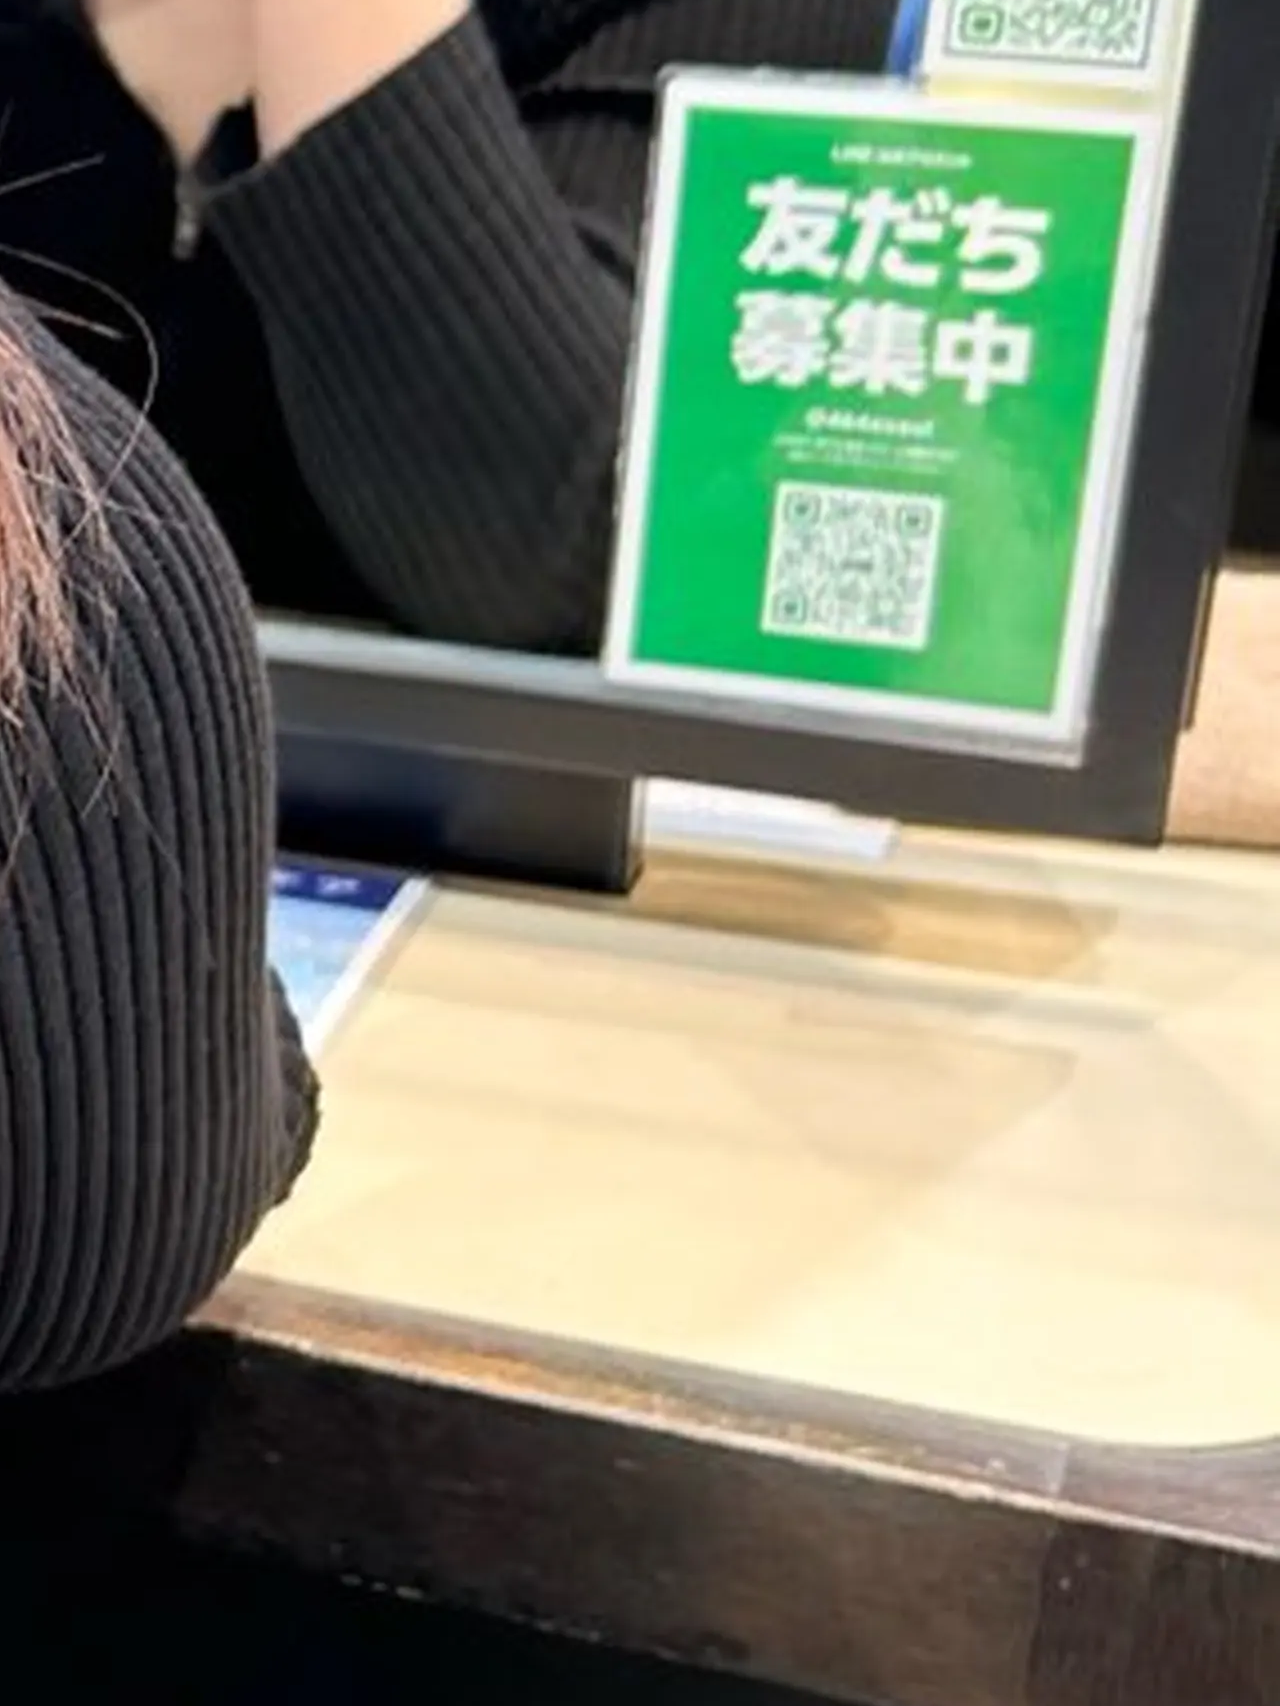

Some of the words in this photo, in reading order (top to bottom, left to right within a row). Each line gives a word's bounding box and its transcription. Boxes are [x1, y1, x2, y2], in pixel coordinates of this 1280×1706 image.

[741, 176, 1050, 292] 友だち
[730, 290, 1033, 404] 募集中
